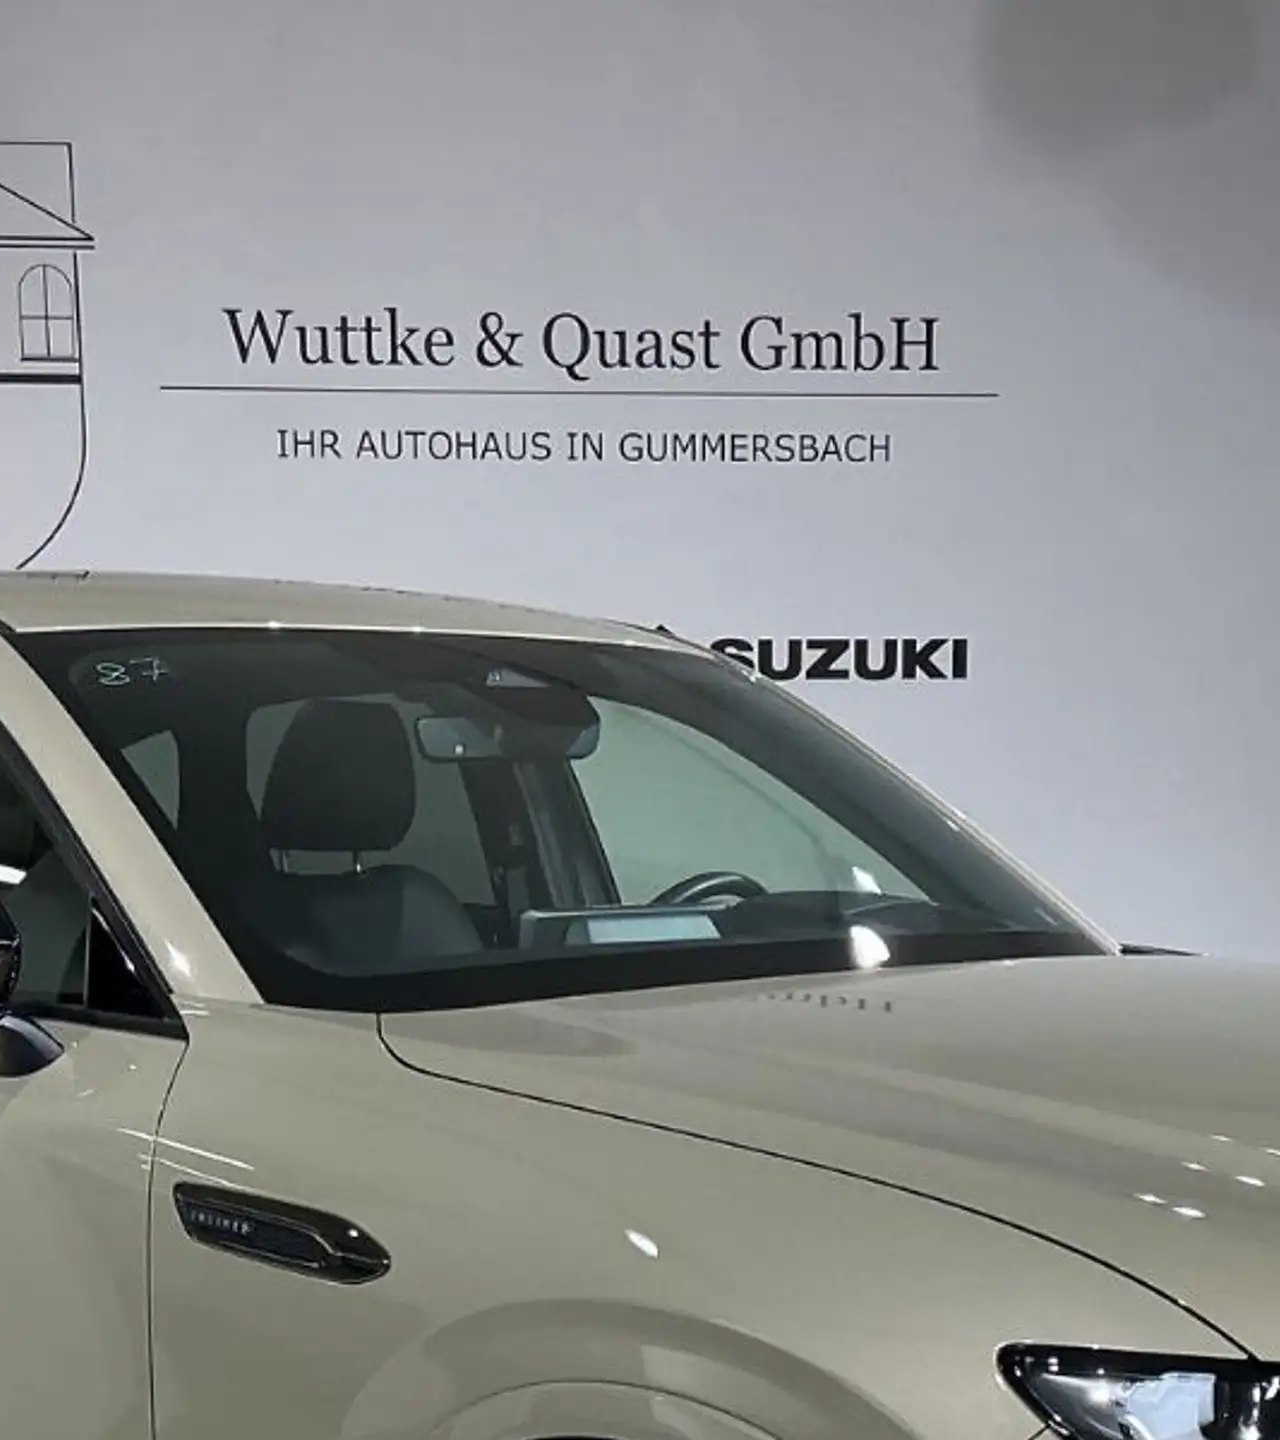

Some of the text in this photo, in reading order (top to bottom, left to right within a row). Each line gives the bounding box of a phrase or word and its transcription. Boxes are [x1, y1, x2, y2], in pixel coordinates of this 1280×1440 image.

[222, 307, 940, 382] Wuttke & Quast GmbH
[276, 428, 891, 464] IHR AUTOHAUS IN GUMMERSBACH
[95, 657, 169, 686] 87
[710, 638, 968, 681] SUZUKI
